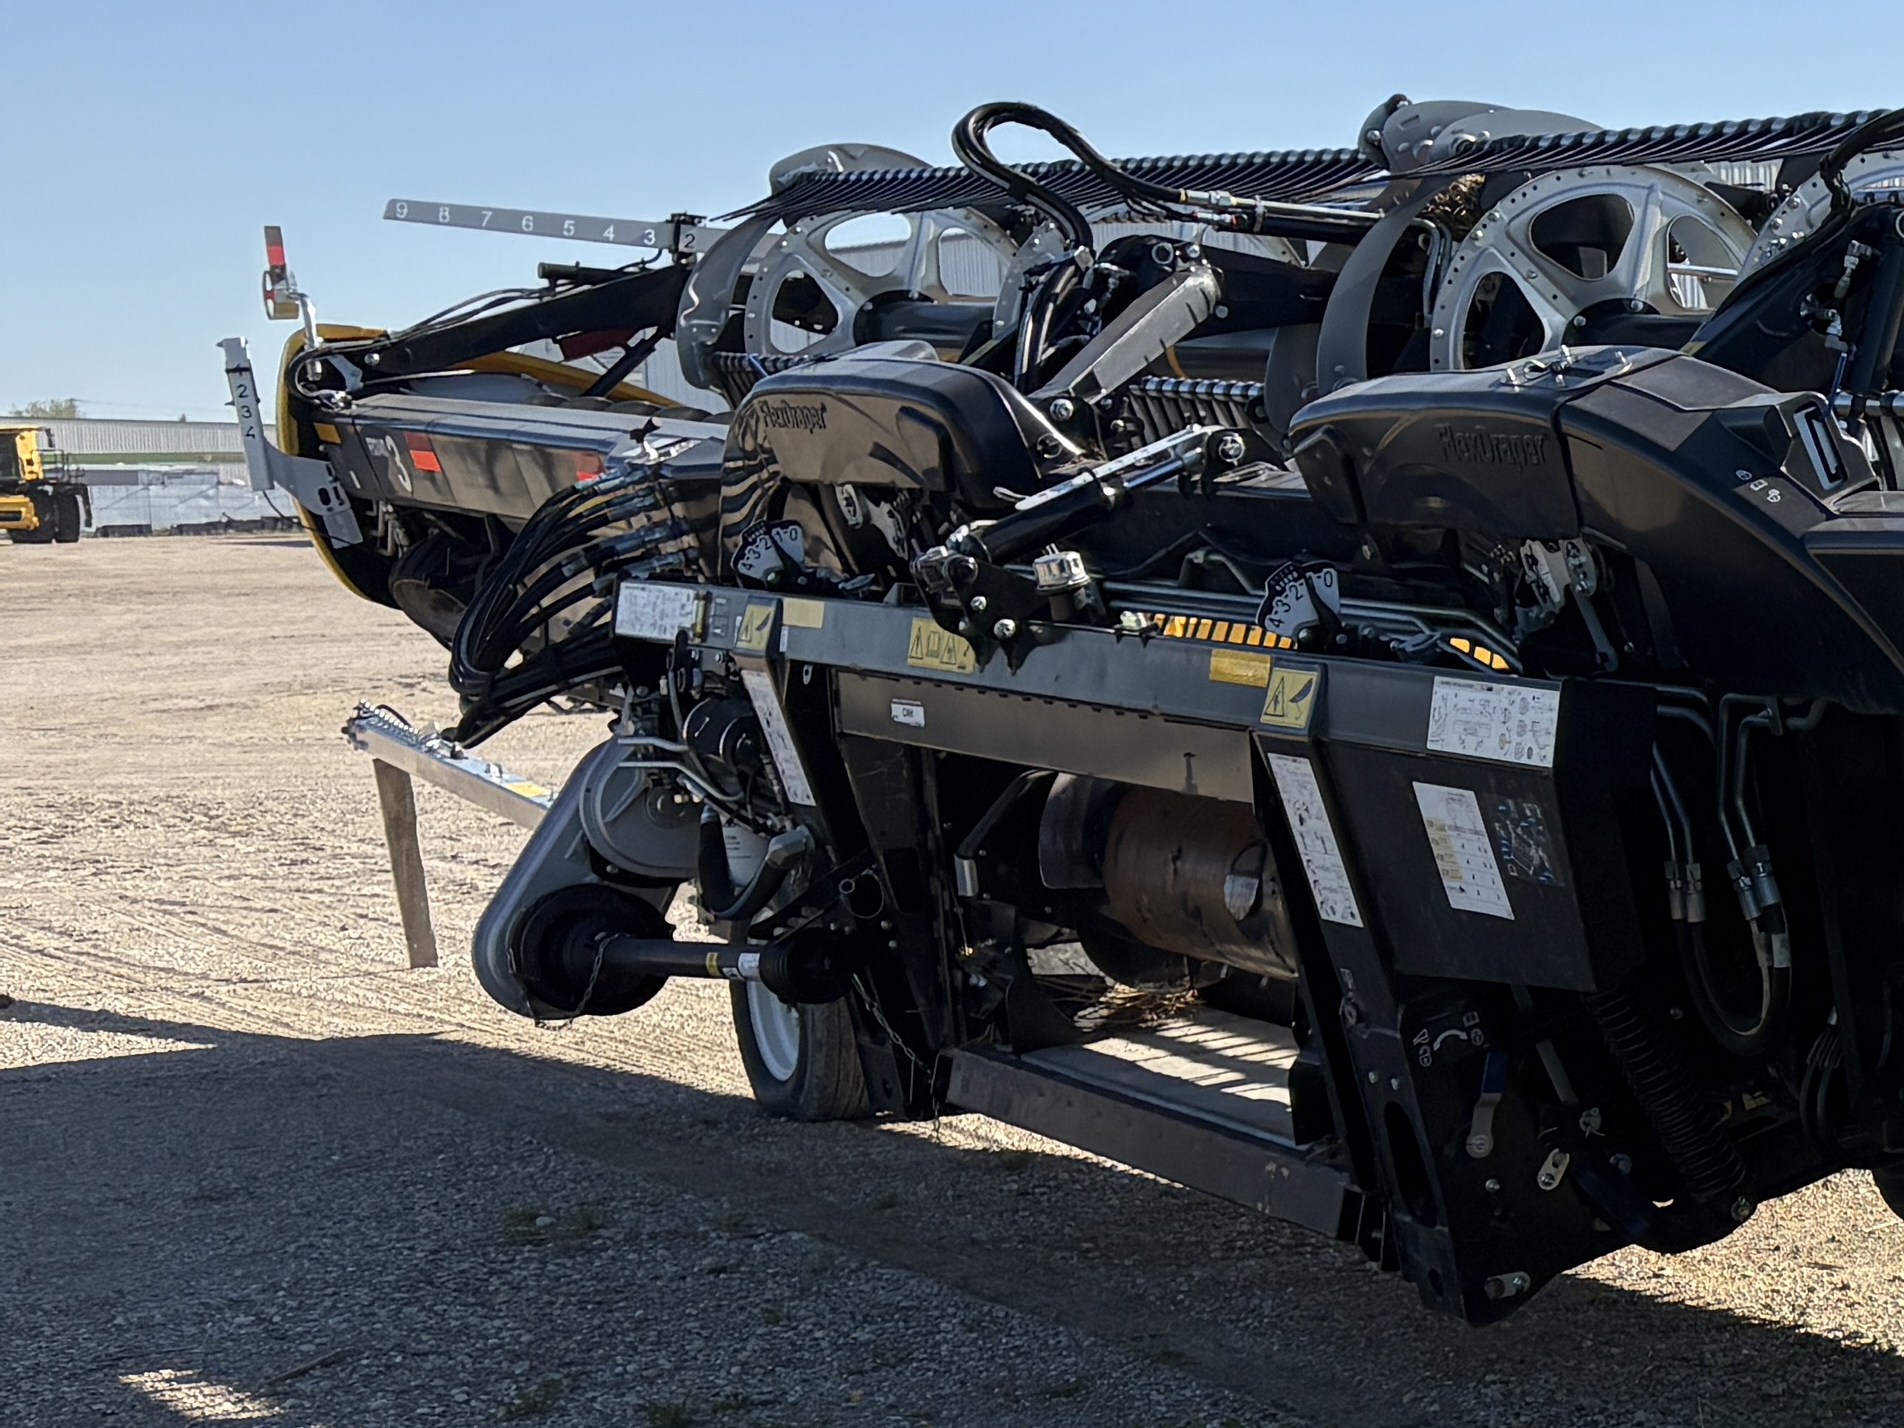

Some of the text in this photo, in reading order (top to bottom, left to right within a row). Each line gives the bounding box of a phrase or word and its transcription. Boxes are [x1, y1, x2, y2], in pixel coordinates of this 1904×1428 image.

[395, 202, 696, 249] 9 8 7 6 5 4 3 2
[236, 383, 249, 399] 2
[240, 405, 252, 419] 3
[385, 435, 412, 492] 3
